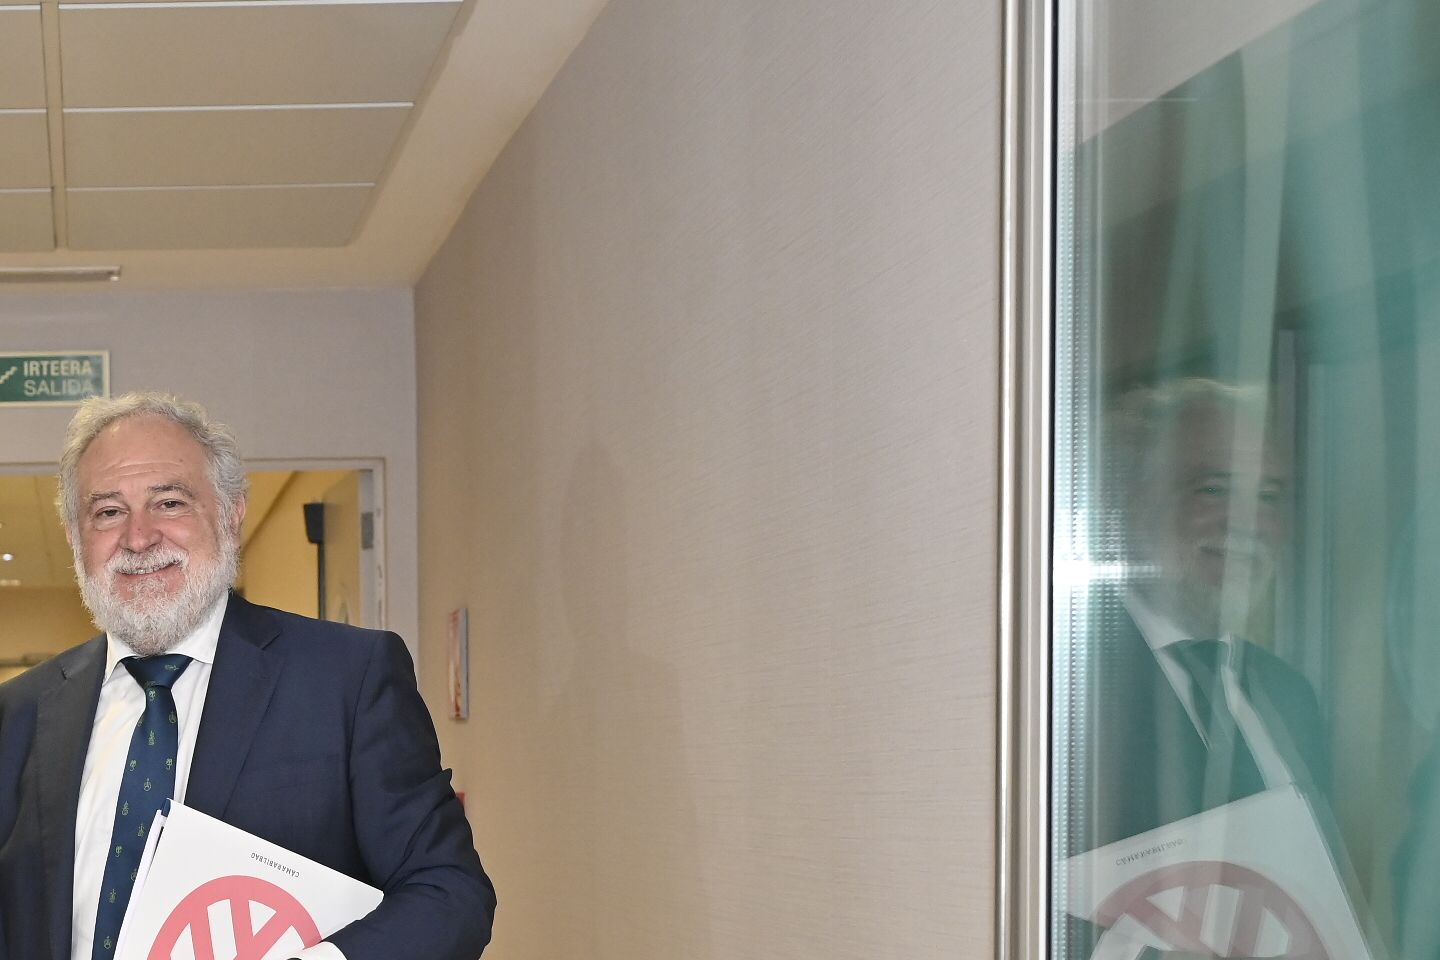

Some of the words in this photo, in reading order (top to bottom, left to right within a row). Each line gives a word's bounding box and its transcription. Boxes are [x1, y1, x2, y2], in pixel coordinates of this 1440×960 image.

[23, 360, 93, 377] IRTEERA
[23, 379, 95, 397] SALIDA
[250, 852, 300, 878] CAMARABILBAO
